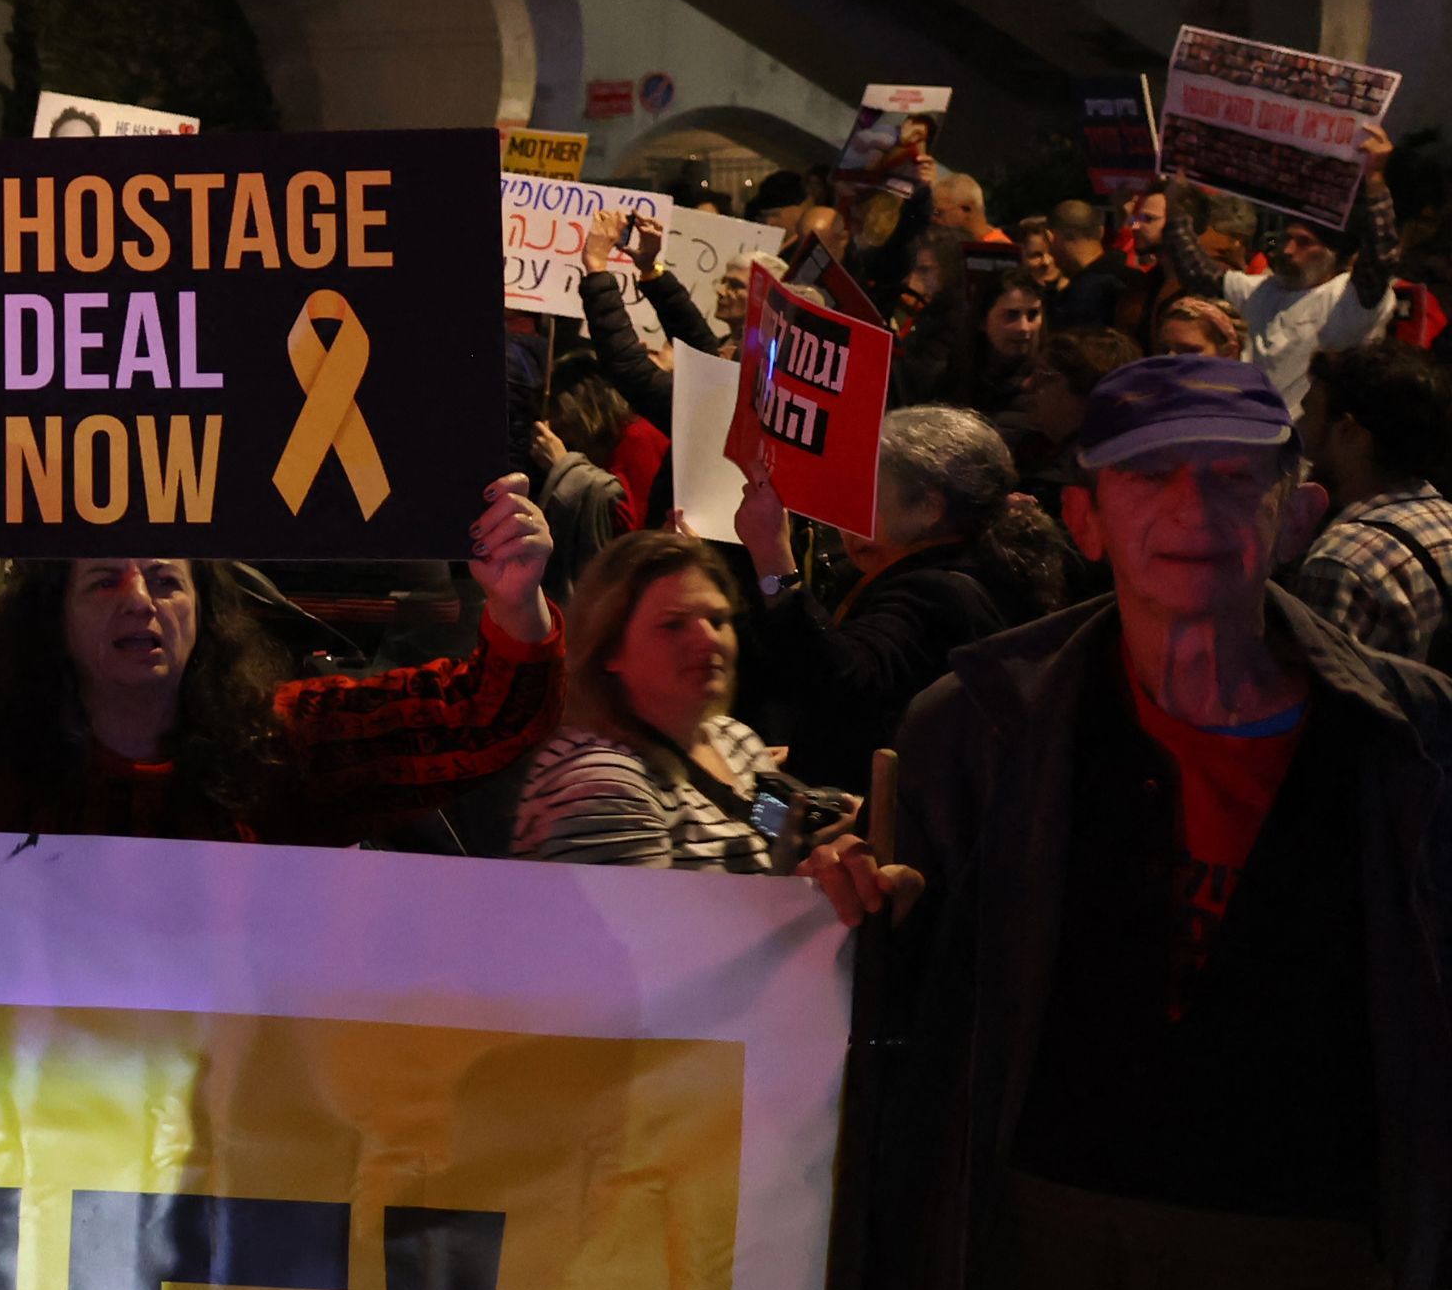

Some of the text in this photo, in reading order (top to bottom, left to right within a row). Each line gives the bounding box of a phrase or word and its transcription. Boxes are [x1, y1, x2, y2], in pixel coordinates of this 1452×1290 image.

[507, 136, 582, 163] MOTHER
[1, 169, 395, 274] HOSTAGE
[503, 256, 551, 292] עכ
[3, 290, 225, 391] DEAL
[786, 324, 851, 393] נגמר
[4, 413, 224, 525] NOW
